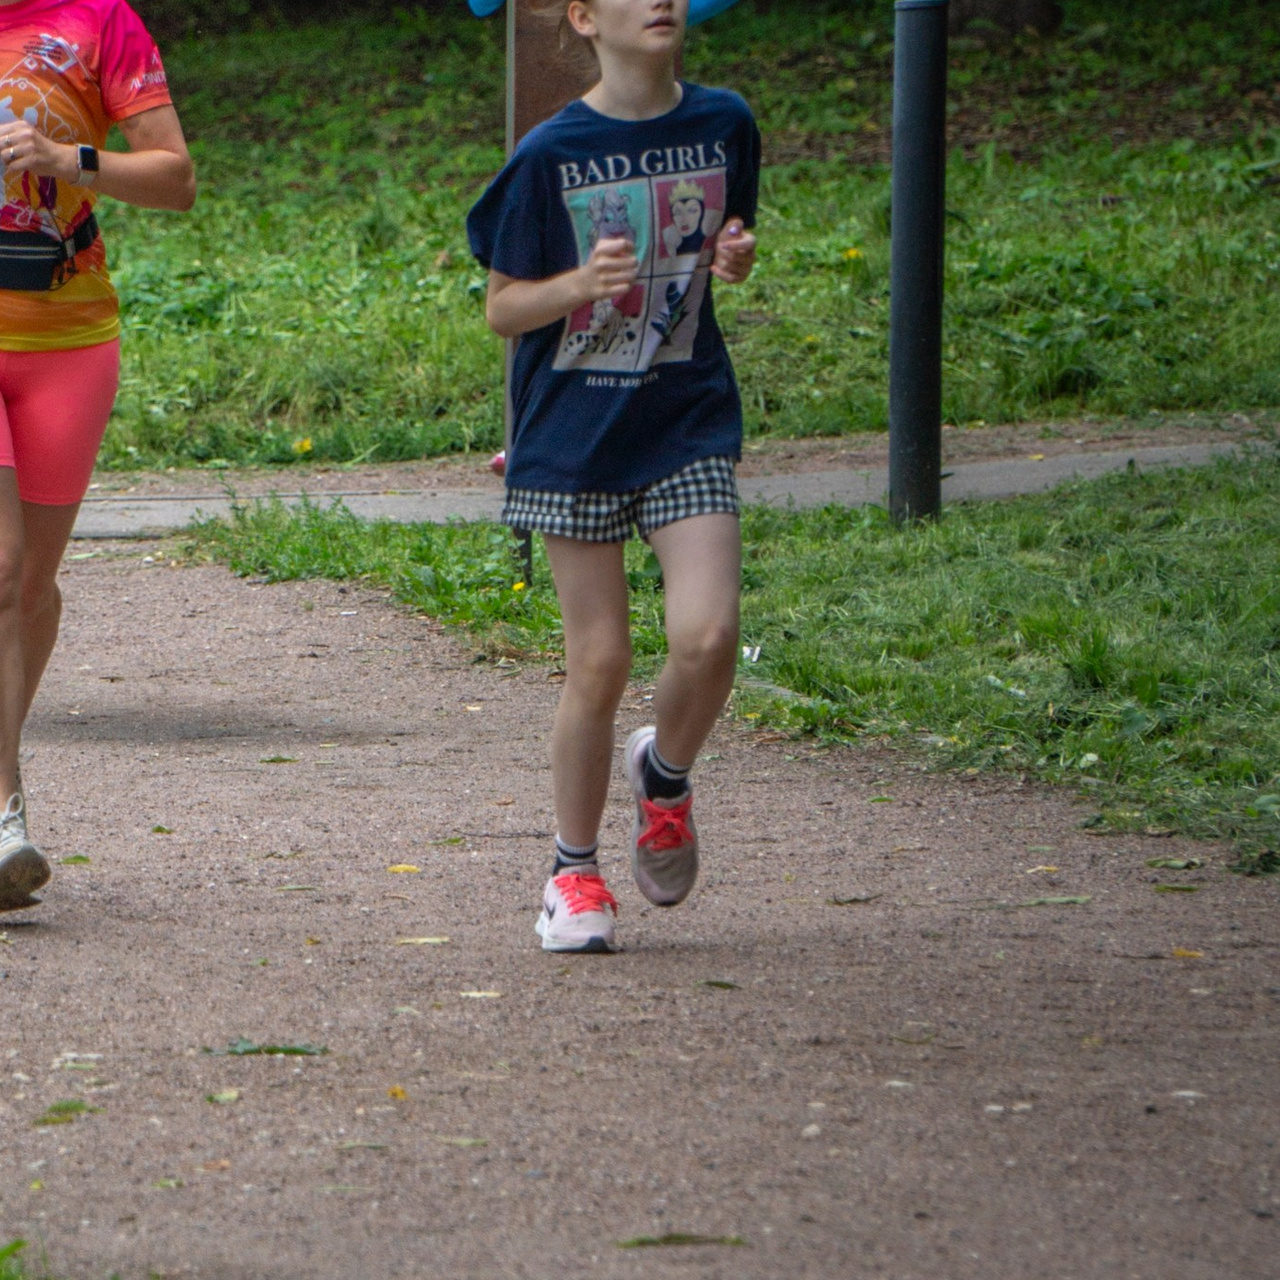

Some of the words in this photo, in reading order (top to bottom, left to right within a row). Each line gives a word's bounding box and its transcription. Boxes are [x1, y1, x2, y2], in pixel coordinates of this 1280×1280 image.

[558, 154, 631, 189] BAD
[639, 141, 727, 175] GIRLS
[585, 375, 617, 387] HAVE
